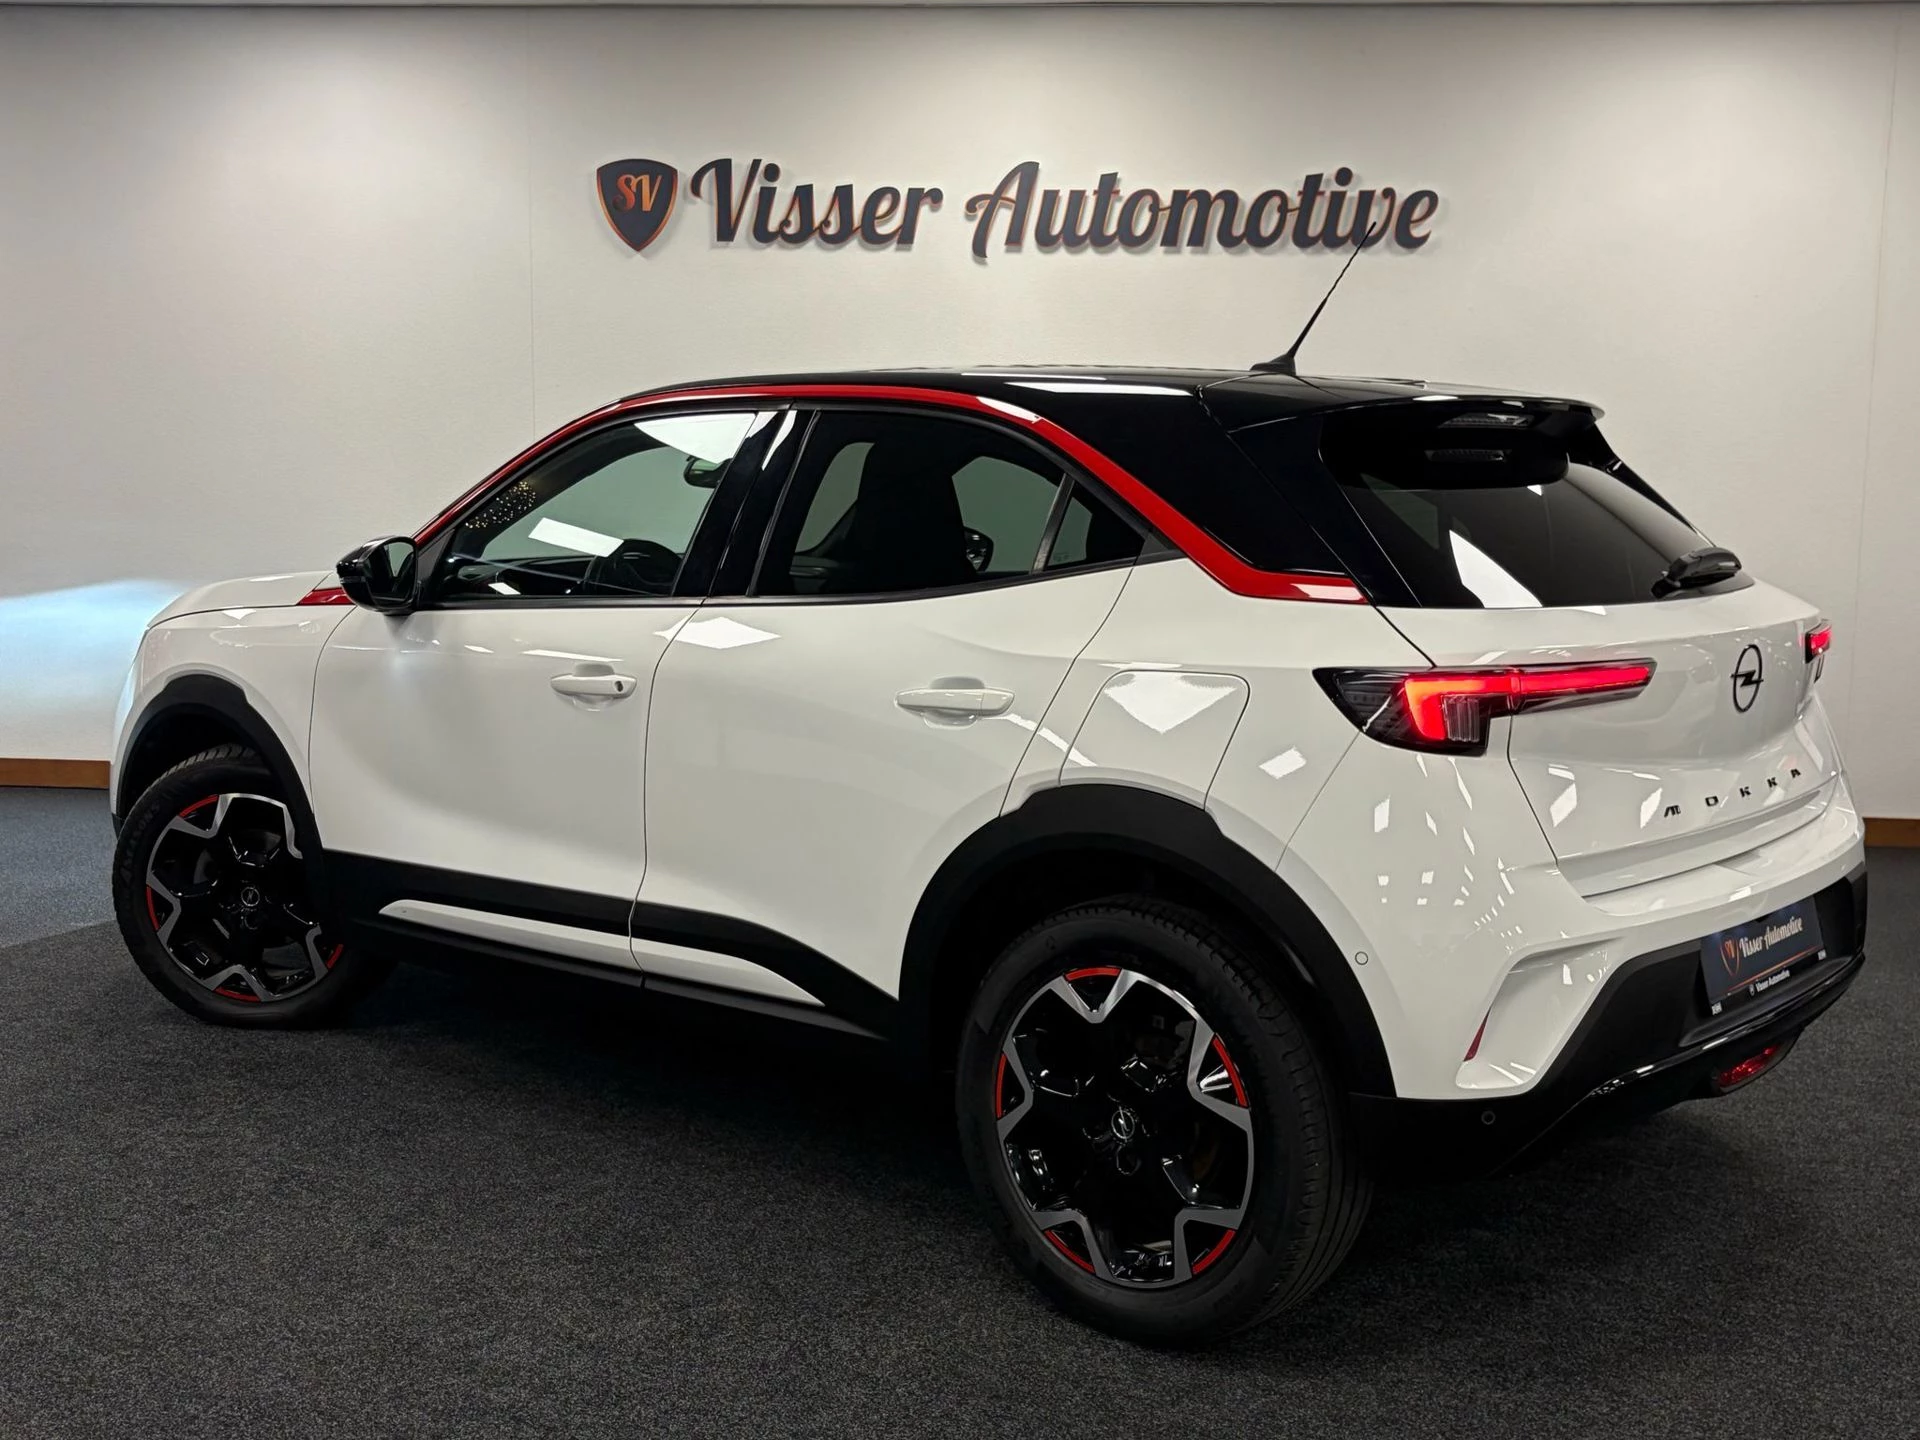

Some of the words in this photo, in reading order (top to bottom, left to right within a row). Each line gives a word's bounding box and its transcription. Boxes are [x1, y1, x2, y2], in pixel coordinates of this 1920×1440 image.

[612, 174, 662, 212] SV
[690, 158, 944, 245] Visser
[965, 161, 1439, 258] Automotive
[1664, 768, 1802, 818] MOKKA
[1739, 936, 1763, 958] Visser
[1764, 915, 1803, 950] Automotive
